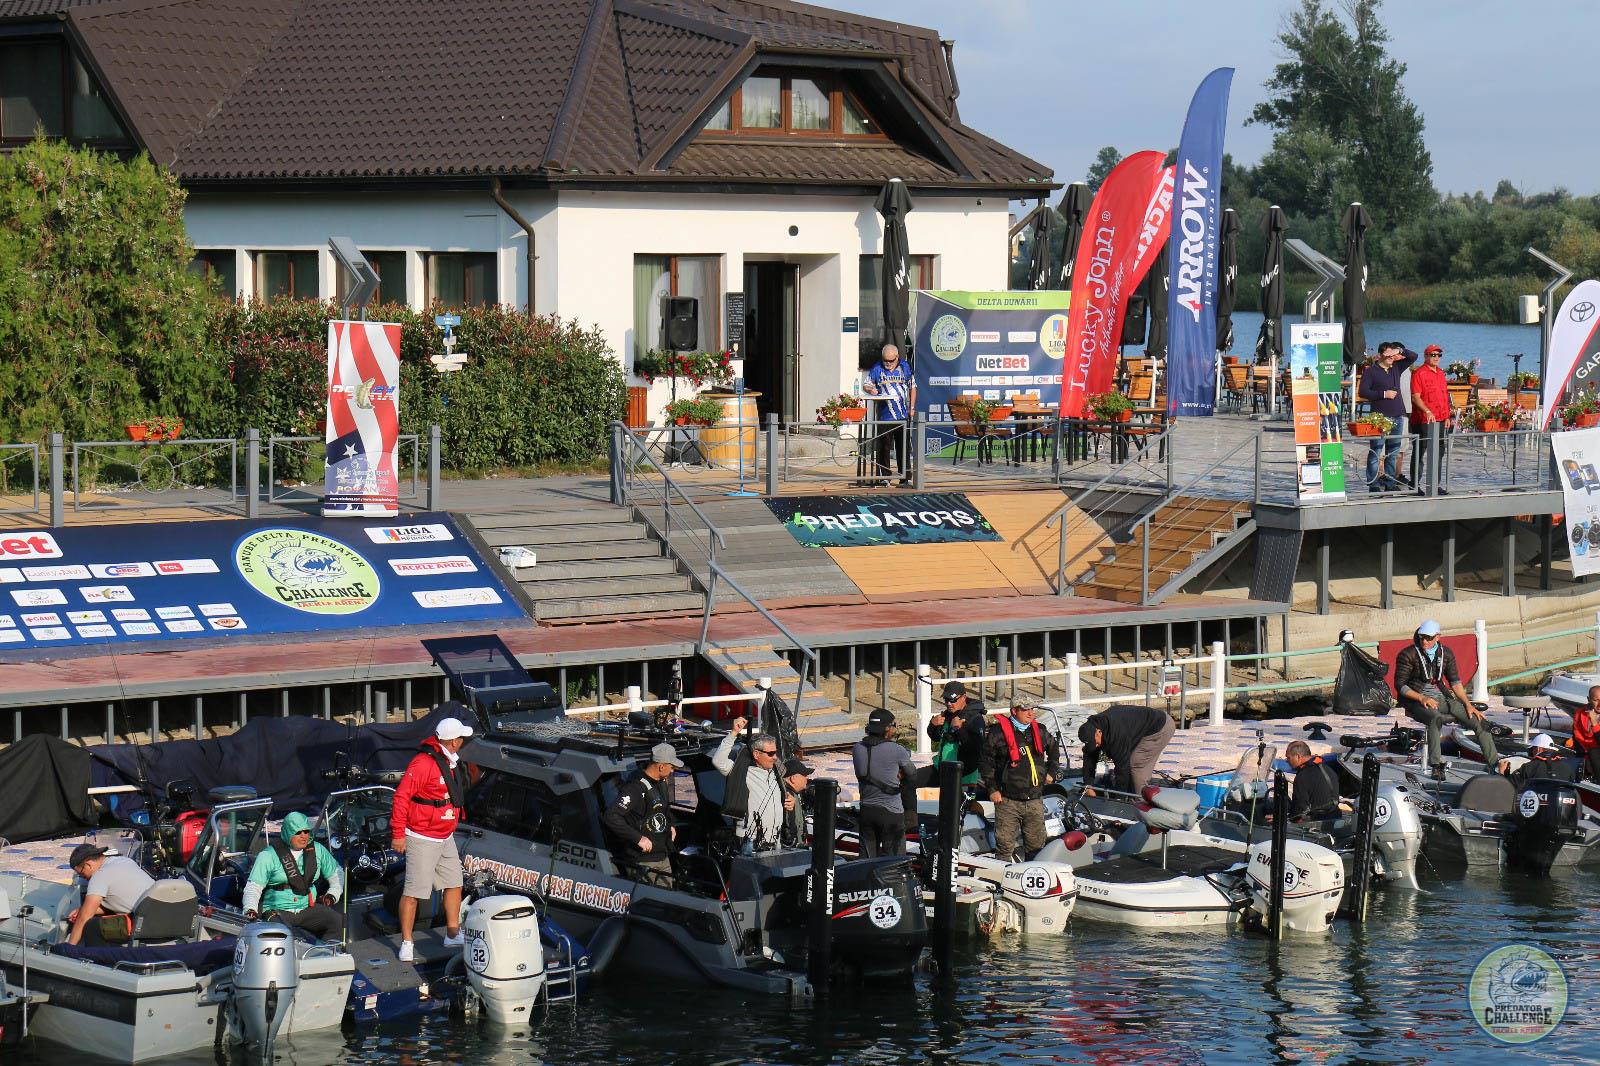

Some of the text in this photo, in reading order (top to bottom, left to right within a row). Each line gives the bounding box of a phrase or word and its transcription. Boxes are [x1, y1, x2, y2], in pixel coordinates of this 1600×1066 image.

[1177, 159, 1208, 323] ARROW
[977, 298, 1002, 306] DELTA
[1070, 226, 1115, 392] Lucky John
[979, 357, 1027, 369] NetBet
[395, 527, 432, 535] LIGA
[0, 536, 53, 555] et
[241, 532, 366, 573] DANUBE DELTA PREDATOR
[394, 563, 433, 571] TACKLE
[275, 582, 372, 601] CHALLENGE
[1523, 799, 1535, 810] 42
[541, 873, 574, 901] CASA
[1026, 876, 1045, 888] 36
[826, 866, 835, 915] TALON
[838, 887, 894, 903] SUZUKI
[874, 905, 897, 920] 34
[259, 947, 286, 956] 40
[473, 948, 486, 963] 32
